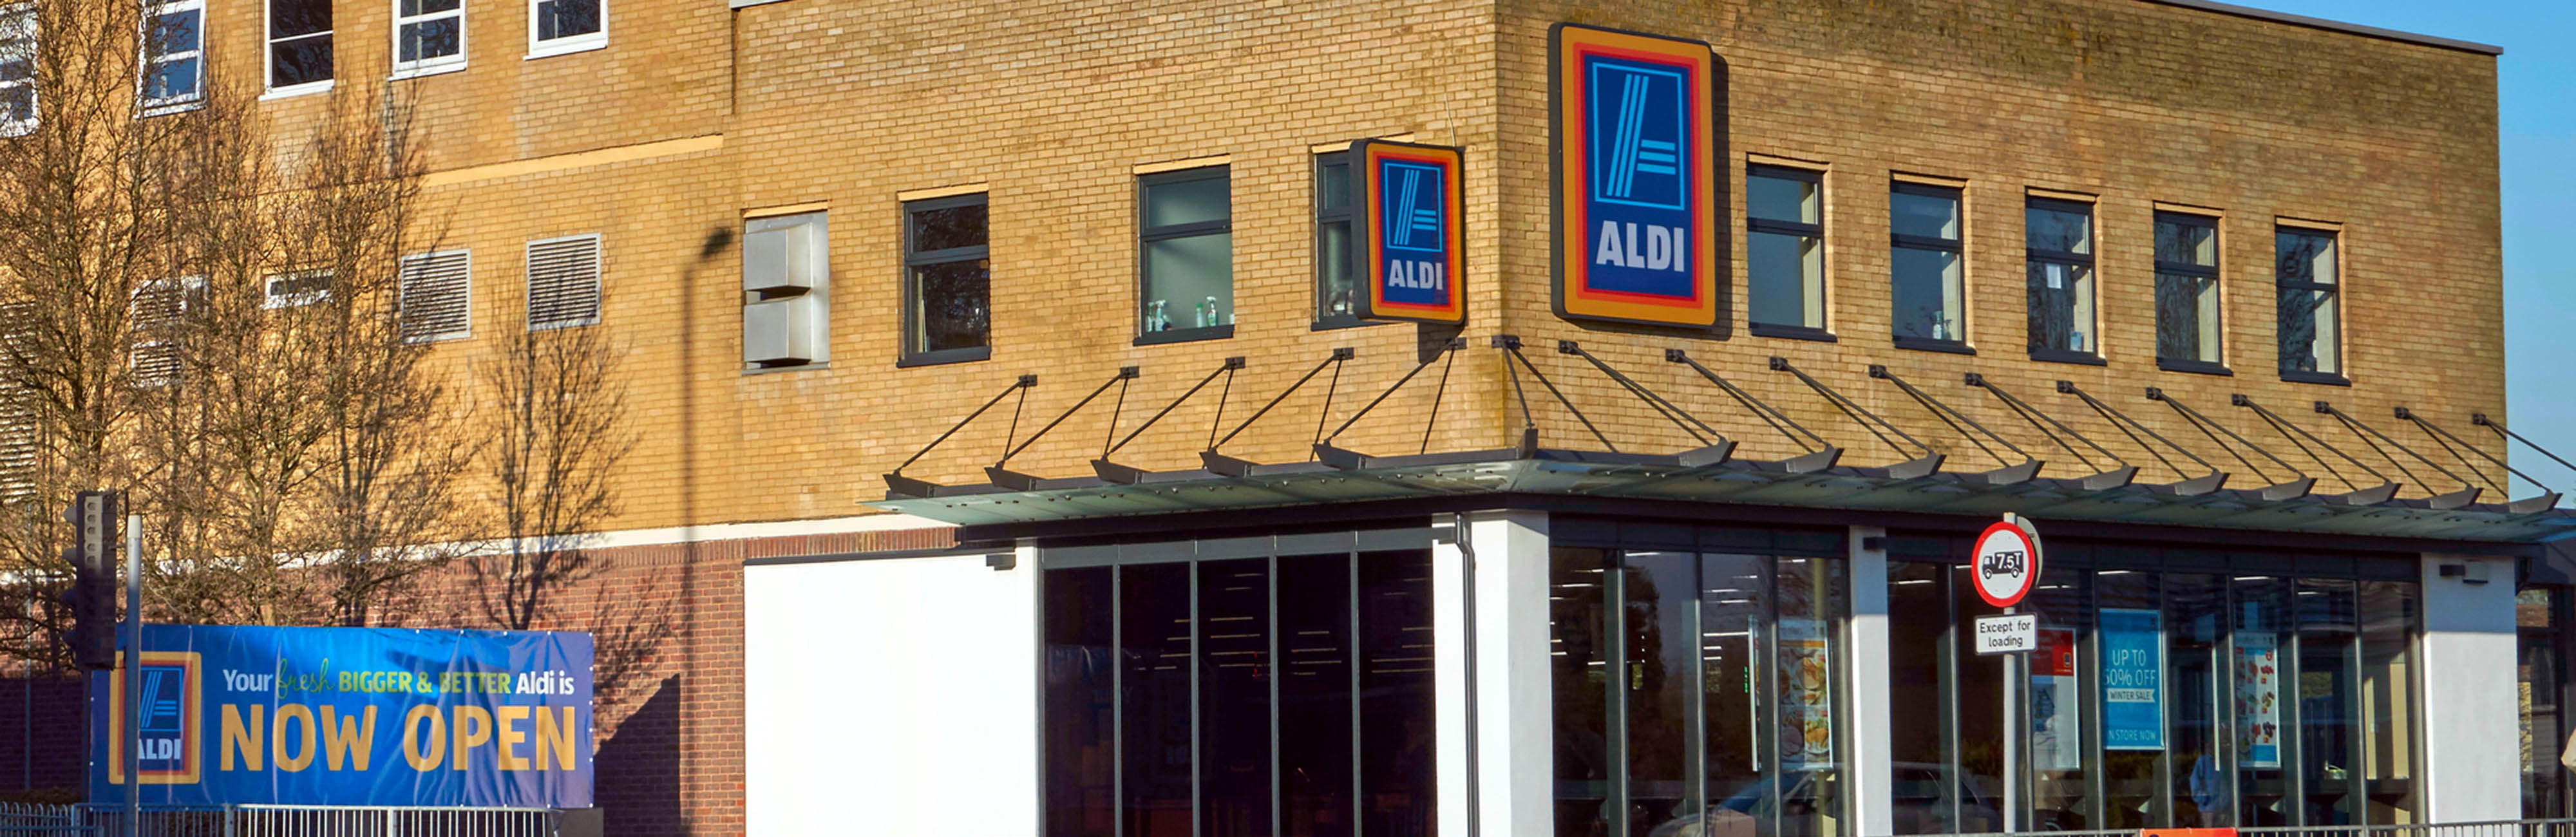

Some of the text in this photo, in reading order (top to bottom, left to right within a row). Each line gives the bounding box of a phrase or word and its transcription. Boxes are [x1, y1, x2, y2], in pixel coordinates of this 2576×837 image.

[1596, 220, 1685, 272] ALDI
[1388, 259, 1443, 290] ALDI
[1996, 552, 2022, 569] 7.5T
[1980, 620, 2031, 634] Except for
[1989, 636, 2023, 648] loading
[2112, 649, 2146, 666] UP TO
[223, 657, 575, 699] Your fresh BIGGER & BETTER Aldi is
[2135, 670, 2156, 686] OFF
[2110, 691, 2151, 701] WINTER SALE
[220, 703, 576, 772] NOW OPEN
[2116, 729, 2138, 740] STORE
[2139, 729, 2156, 740] NOW
